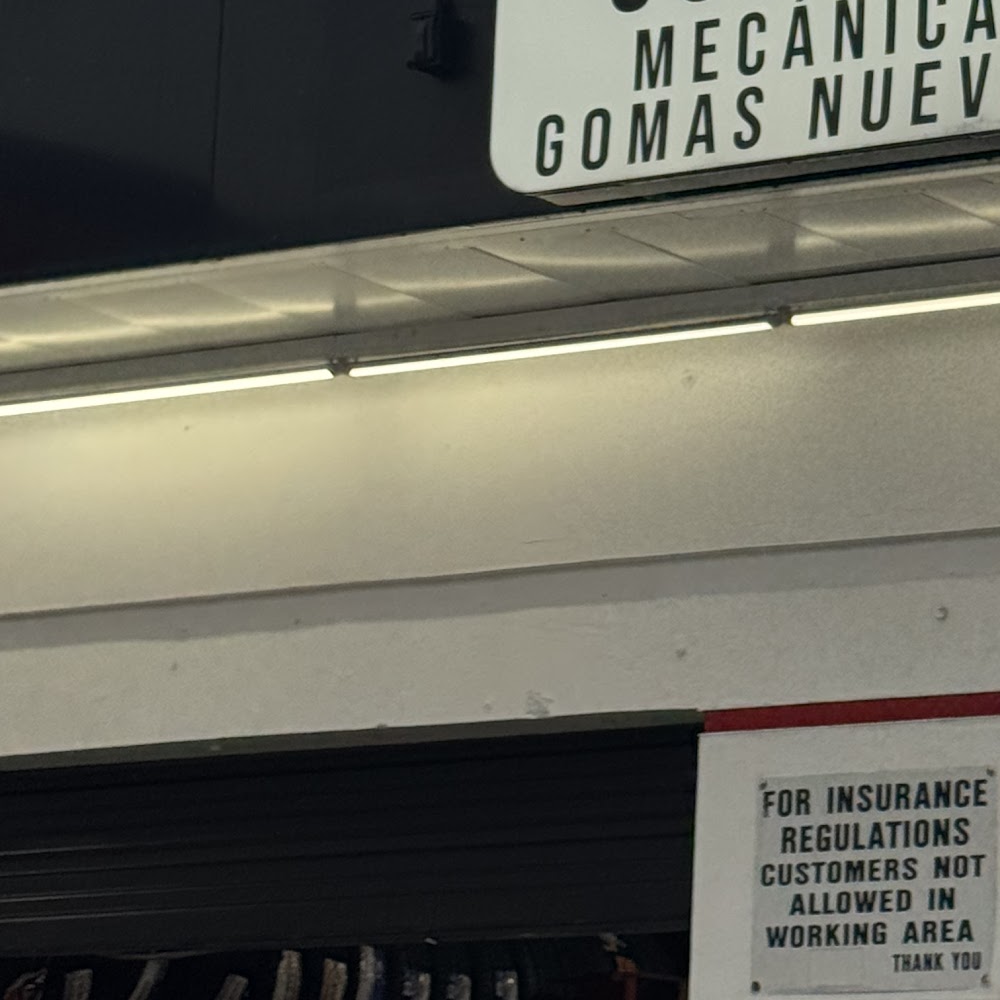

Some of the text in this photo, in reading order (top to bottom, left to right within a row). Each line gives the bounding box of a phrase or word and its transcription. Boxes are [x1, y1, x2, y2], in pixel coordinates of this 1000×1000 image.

[535, 87, 764, 177] GOMAS
[763, 779, 988, 818] FOR INSURANCE
[780, 818, 970, 854] REGULATIONS
[760, 854, 986, 887] CUSTOMERS NOT
[788, 887, 955, 916] ALLOWED IN
[765, 919, 974, 948] WORKING AREA
[892, 952, 982, 973] THANK YOU
